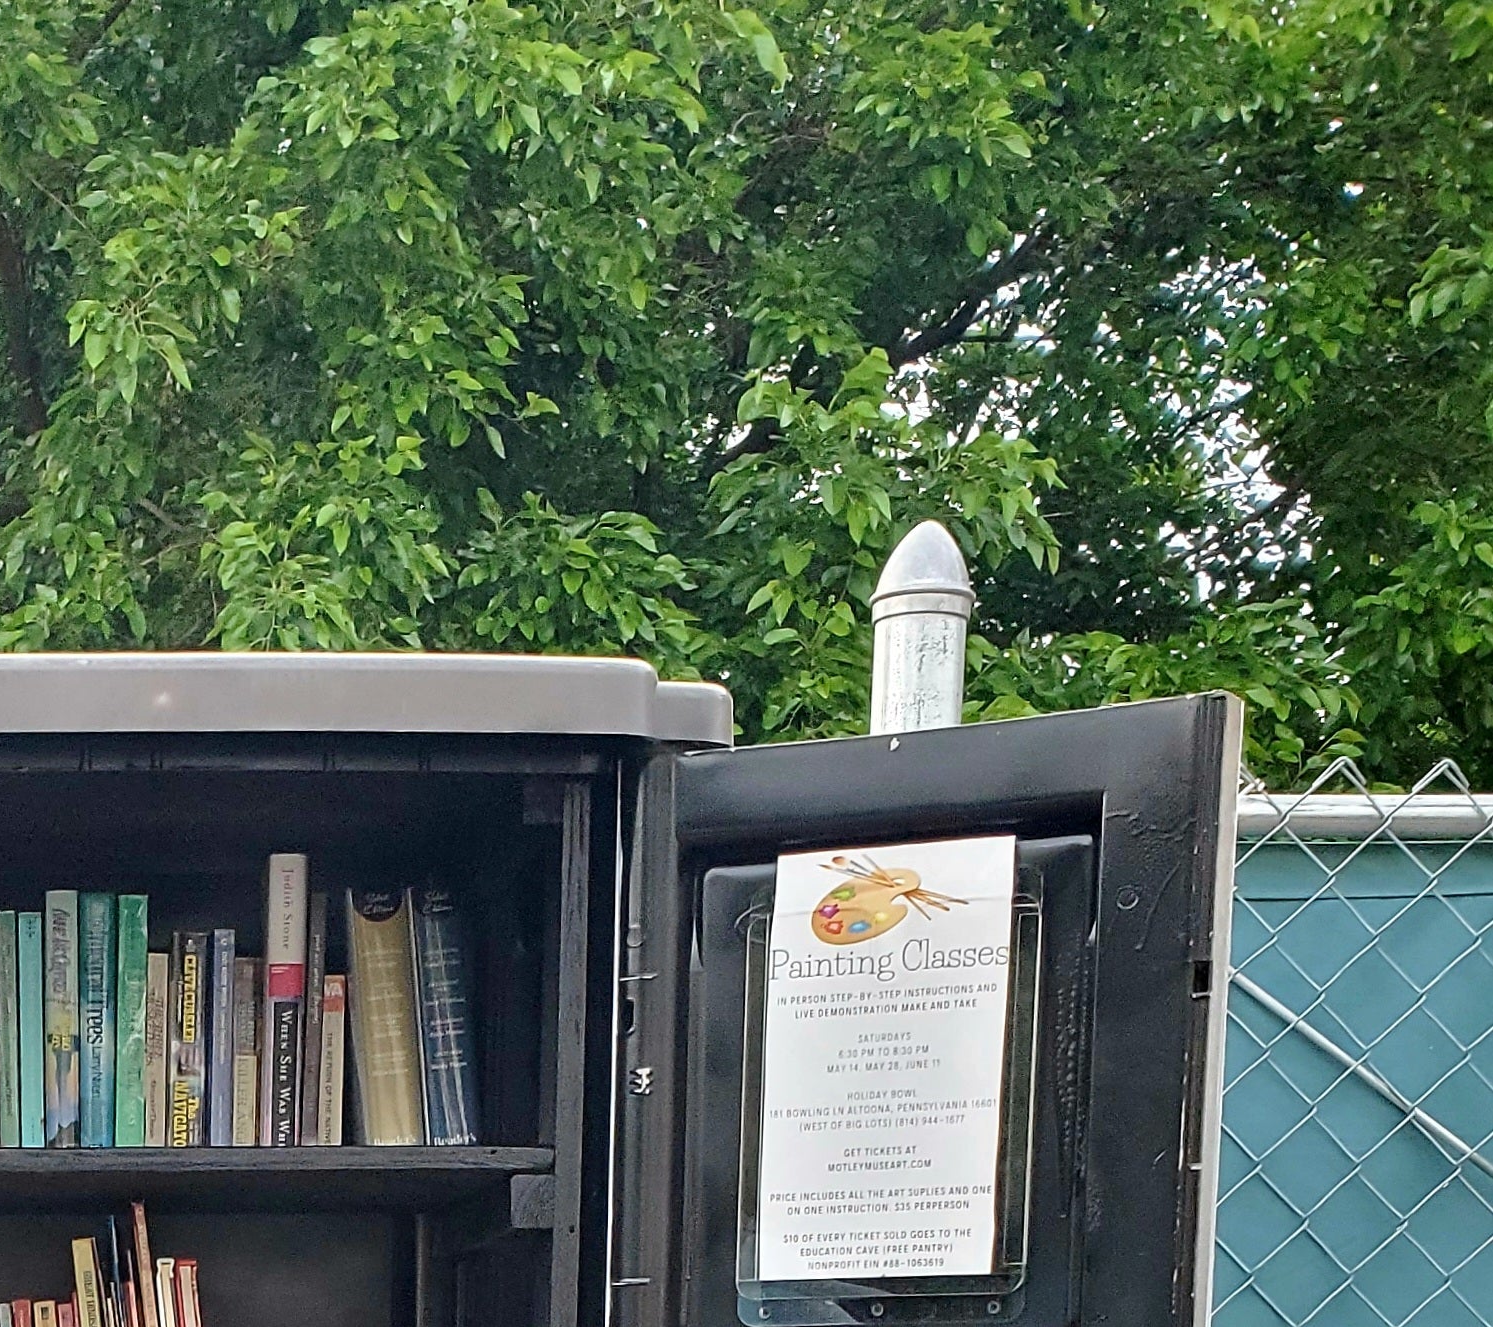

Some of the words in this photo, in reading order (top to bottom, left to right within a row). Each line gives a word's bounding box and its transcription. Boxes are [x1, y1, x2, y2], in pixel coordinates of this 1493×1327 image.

[282, 868, 295, 907] Judith
[282, 914, 292, 949] Stone
[769, 948, 896, 982] Painting
[902, 938, 1009, 972] Classes
[184, 955, 196, 990] CLIVE
[778, 997, 787, 1006] IN
[790, 994, 827, 1004] PERSON
[830, 989, 901, 1003] STEP-BY-STEP
[904, 984, 974, 998] INSTRUCTIONS
[977, 983, 998, 993] AND
[183, 991, 195, 1043] CUSSLER
[795, 1009, 815, 1019] LIVE
[818, 1004, 898, 1018] DEMONSTRATION
[901, 1002, 928, 1013] MAKE
[930, 1000, 950, 1010] AND
[954, 999, 978, 1009] TAKE
[858, 1032, 912, 1043] SATURDAYS
[861, 1048, 875, 1058] PM
[878, 1047, 890, 1057] TO
[916, 1045, 929, 1054] PM
[827, 1063, 846, 1073] MAY
[865, 1062, 884, 1072] MAY
[905, 1059, 929, 1070] JUNE
[847, 1090, 887, 1101] HOLIDAY
[891, 1089, 916, 1099] BOWL
[173, 1081, 188, 1147] NAVIGATO
[188, 1096, 200, 1119] The
[786, 1107, 830, 1118] BOWLING
[833, 1106, 844, 1115] LN
[897, 1100, 967, 1112] PENNSYLVANIA
[799, 1121, 828, 1132] (WEST
[830, 1121, 842, 1130] OF
[846, 1119, 862, 1129] BIG
[844, 1147, 861, 1157] GET
[865, 1146, 902, 1156] TICKETS
[905, 1145, 917, 1155] AT
[827, 1159, 932, 1172] MOTLEYMUSEART.COM
[770, 1193, 796, 1202] PRICE
[800, 1191, 846, 1201] INCLUDES
[848, 1190, 864, 1199] ALL
[868, 1189, 884, 1199] THE
[887, 1188, 905, 1198] ART
[908, 1186, 946, 1197] SUPLIES
[948, 1185, 969, 1195] AND
[972, 1185, 992, 1195] ONE
[787, 1207, 801, 1216] ON
[804, 1205, 823, 1215] ONE
[914, 1200, 970, 1211] PERPERSON
[783, 1234, 799, 1244] $10
[802, 1234, 813, 1243] OF
[817, 1233, 846, 1242] EVERY
[849, 1231, 880, 1241] TICKET
[883, 1230, 907, 1240] SOLD
[910, 1229, 935, 1239] GOES
[939, 1229, 951, 1238] TO
[954, 1228, 972, 1238] THE
[800, 1246, 853, 1257] EDUCATION
[855, 1245, 879, 1255] CAVE
[883, 1244, 909, 1255] (FREE
[912, 1243, 953, 1253] PANTRY)
[807, 1260, 861, 1270] NONPROFIT
[864, 1259, 879, 1269] EIN
